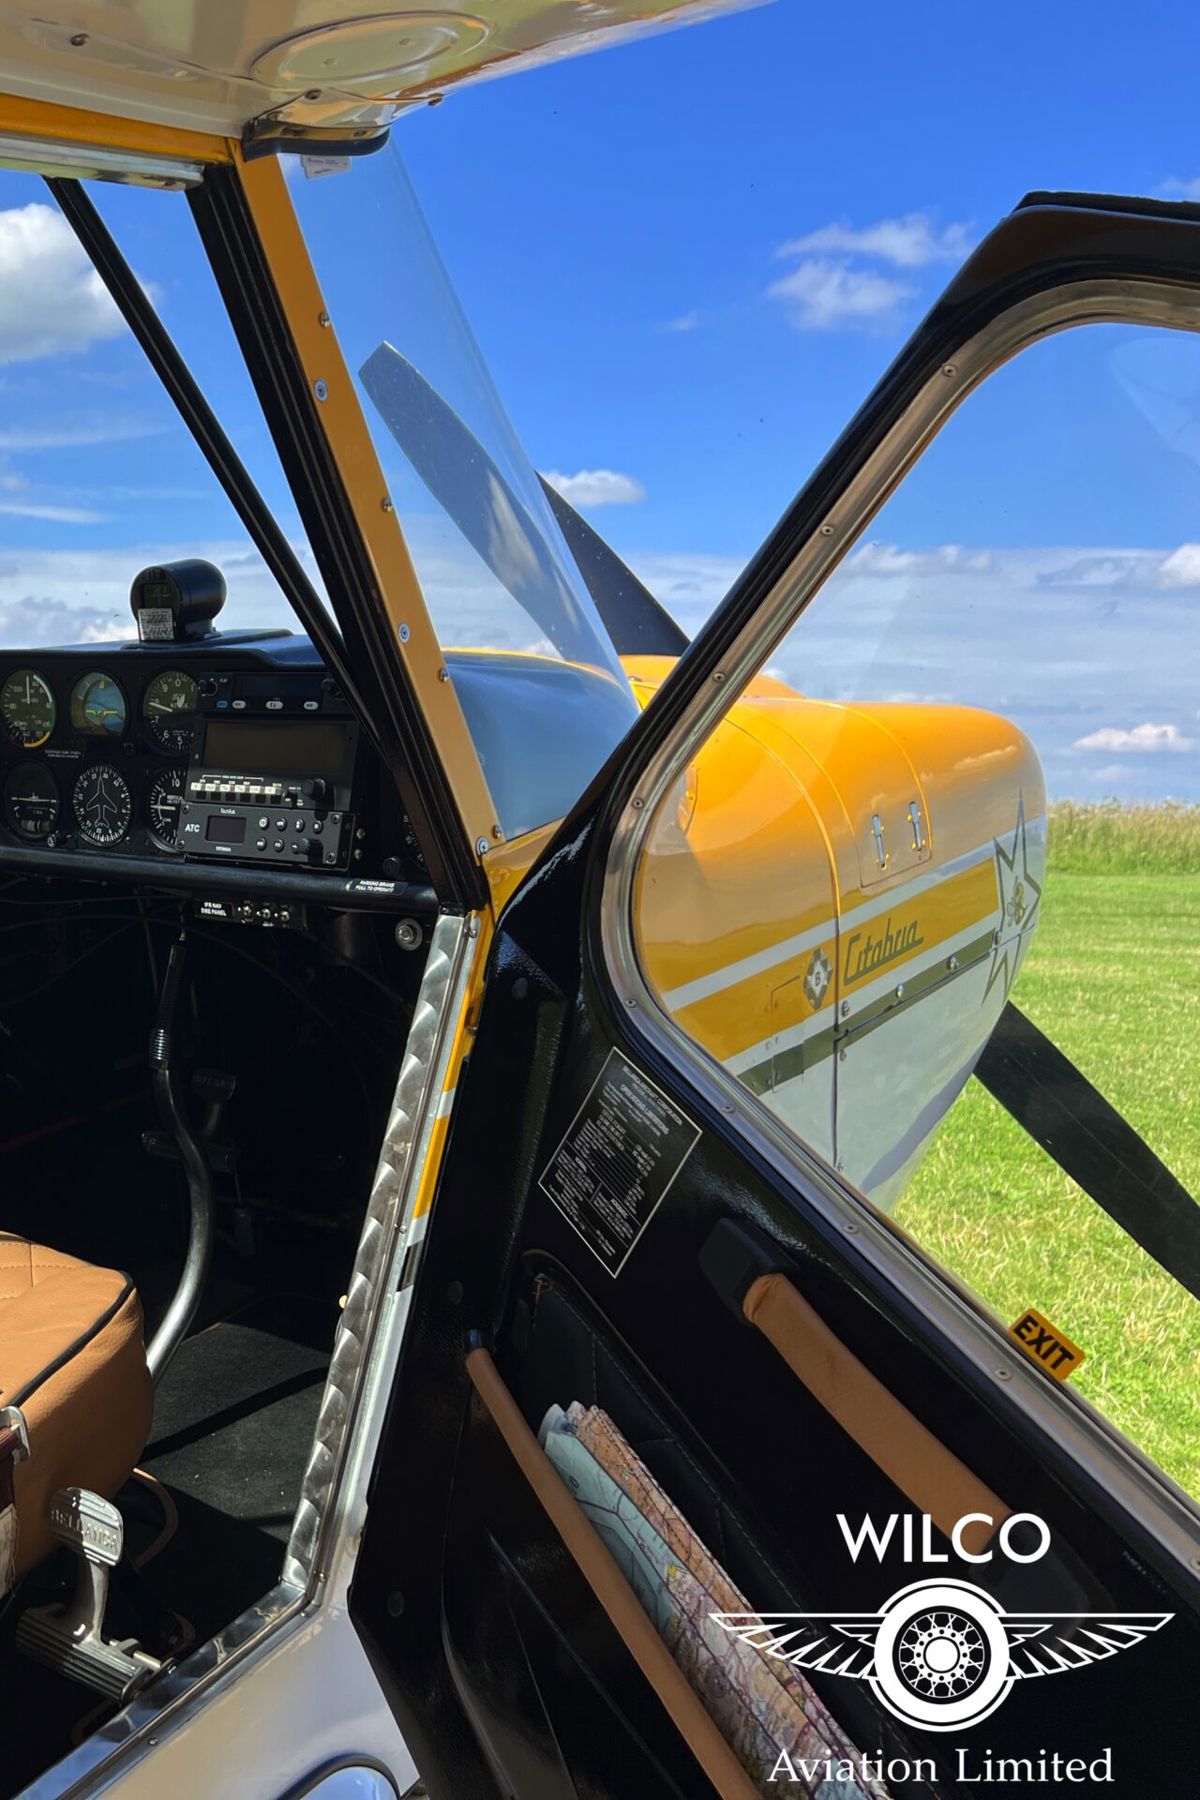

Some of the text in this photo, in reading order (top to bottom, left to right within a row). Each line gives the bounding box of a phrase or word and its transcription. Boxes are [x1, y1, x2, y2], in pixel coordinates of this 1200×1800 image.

[171, 779, 180, 788] 10
[185, 824, 200, 833] ATC
[843, 918, 924, 986] Citabria
[1013, 1314, 1075, 1370] EXIT
